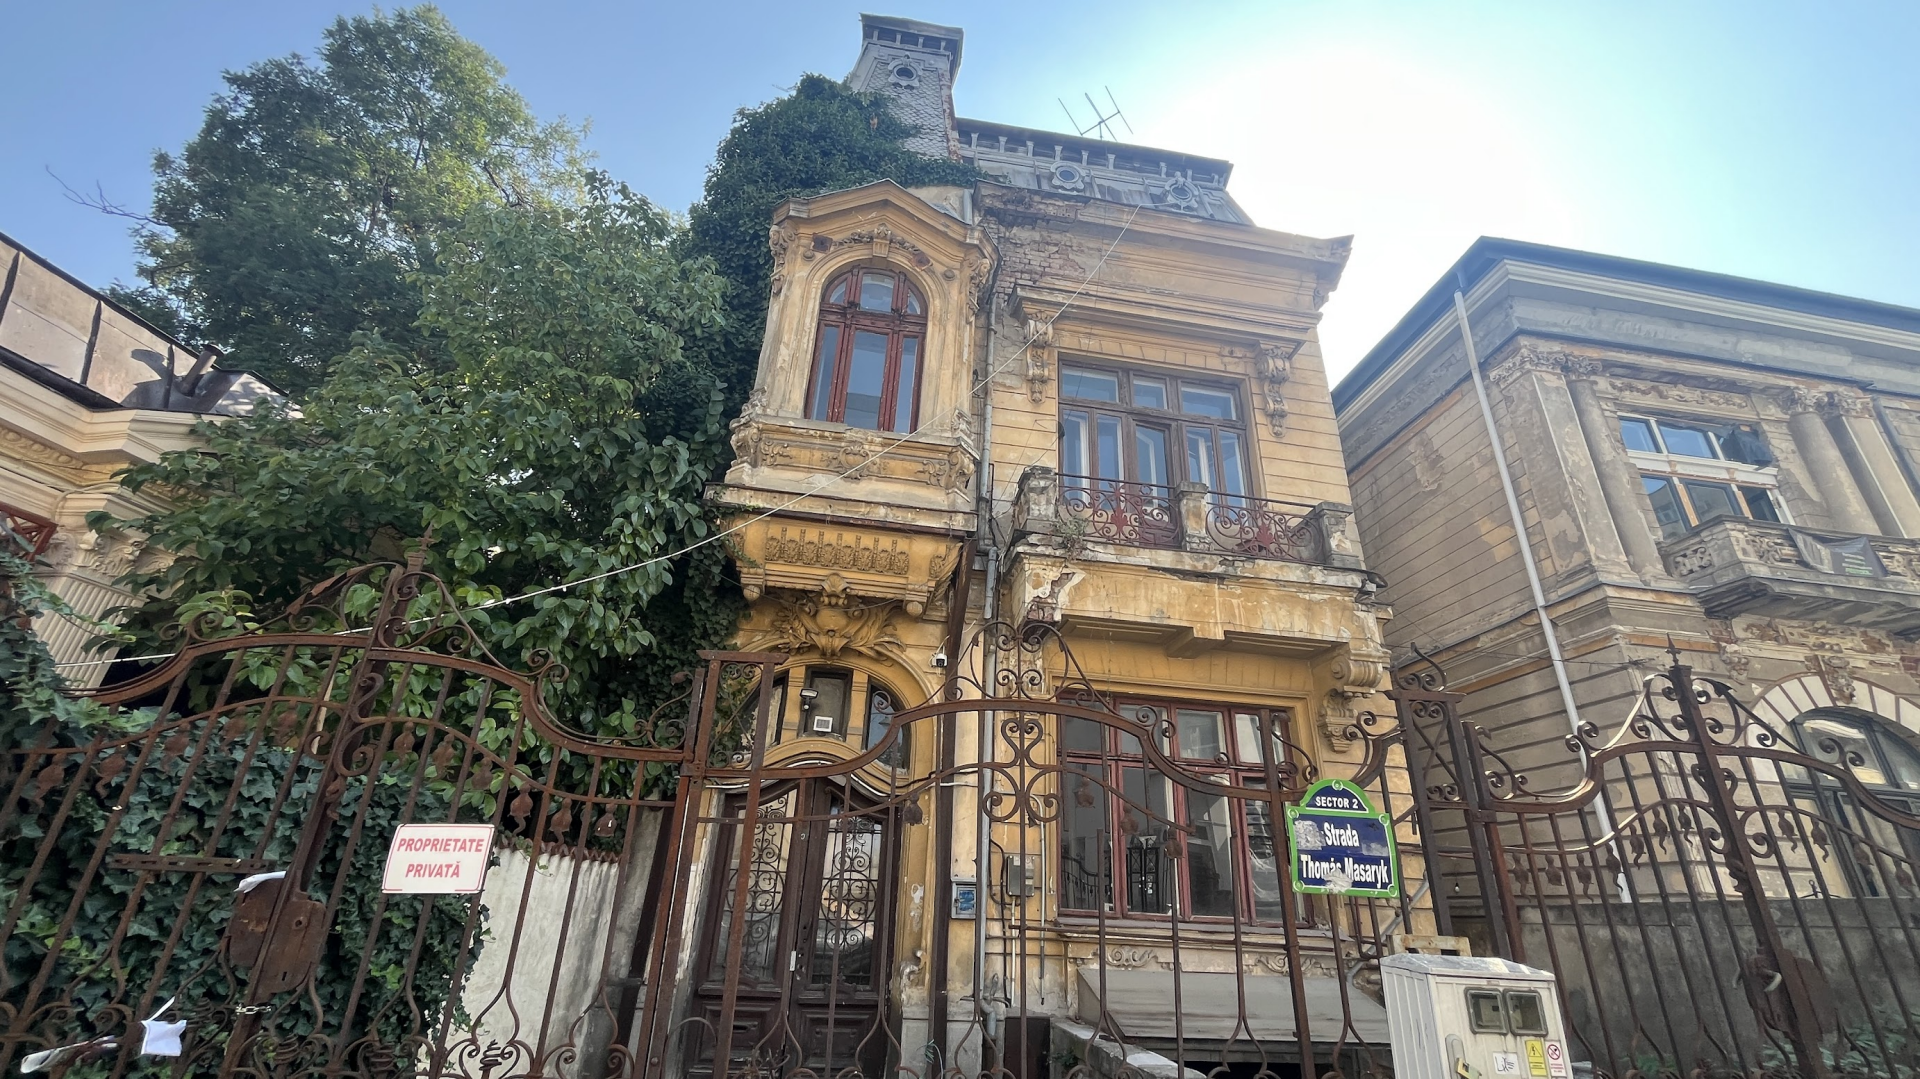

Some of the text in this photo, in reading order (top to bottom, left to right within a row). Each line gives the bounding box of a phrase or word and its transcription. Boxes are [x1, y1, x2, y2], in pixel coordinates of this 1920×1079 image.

[1315, 796, 1359, 809] SECTOR 2
[1323, 822, 1360, 847] Strada
[397, 838, 484, 852] PROPRIETATE
[405, 861, 461, 877] PRIVATĂ
[1344, 857, 1389, 889] Masaryk
